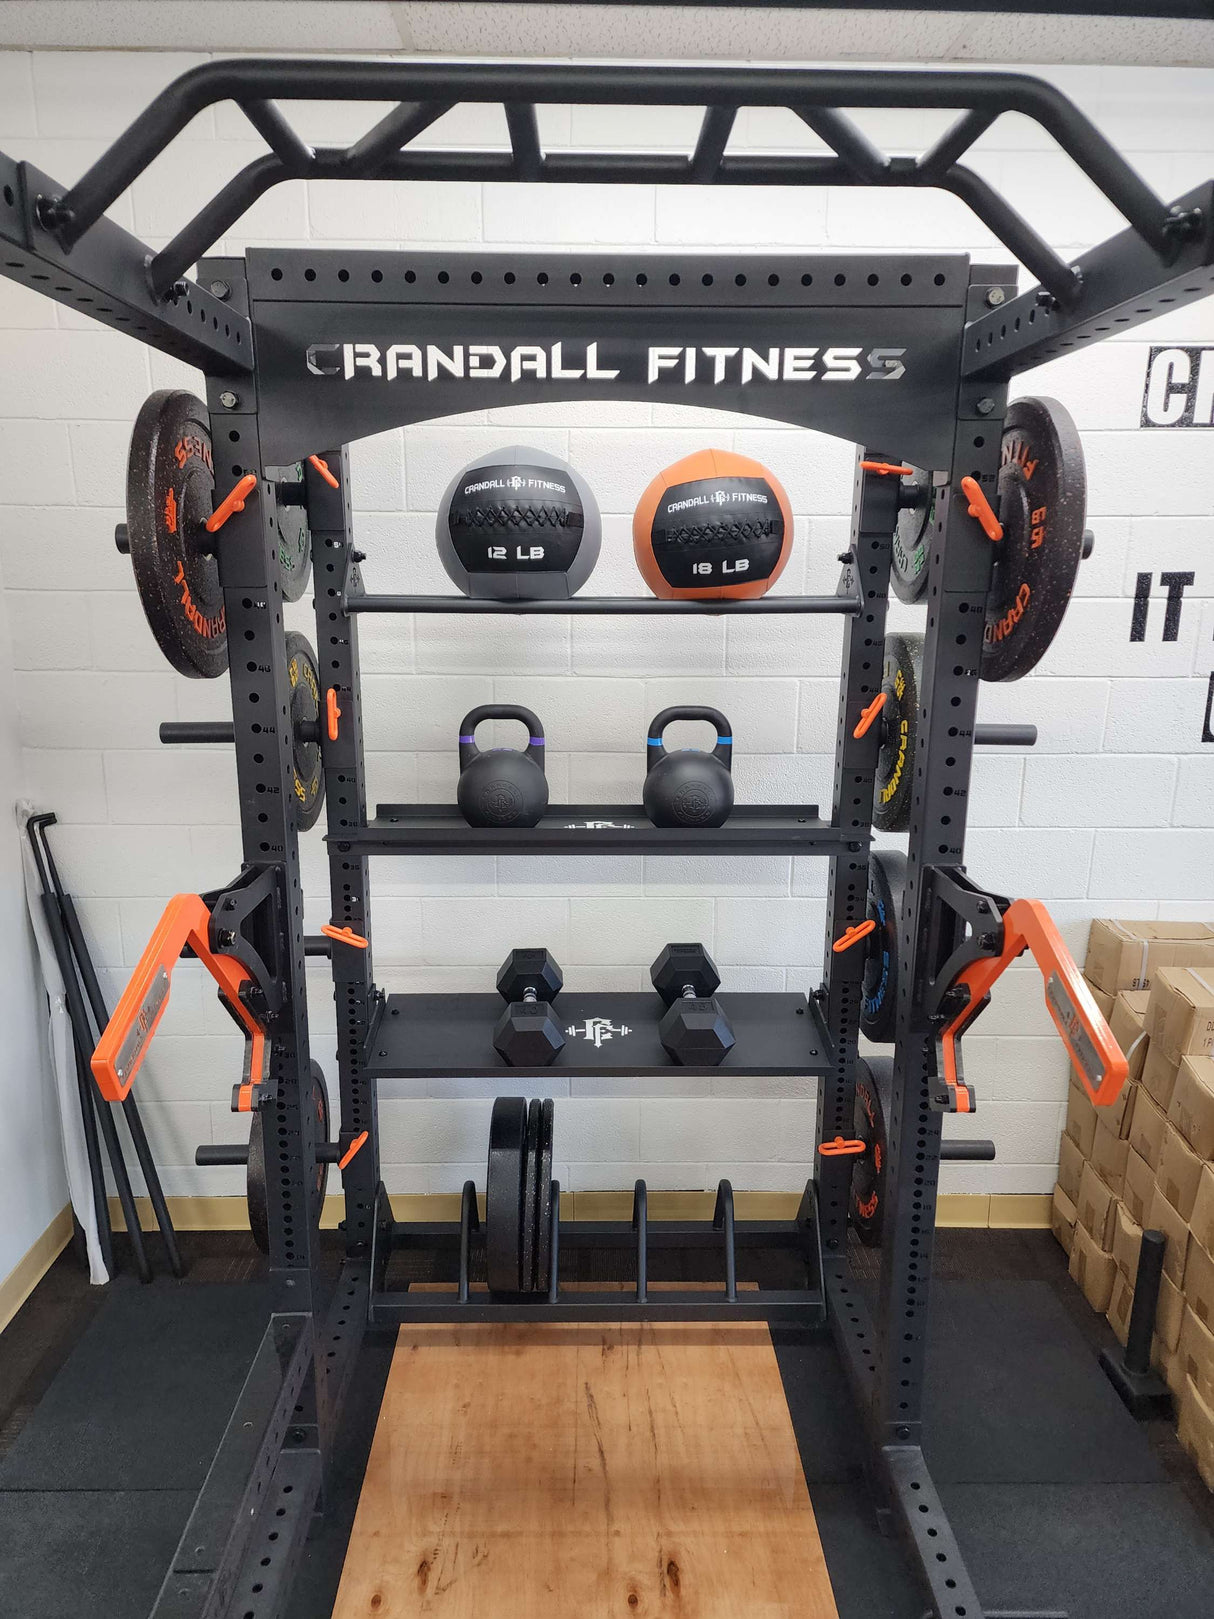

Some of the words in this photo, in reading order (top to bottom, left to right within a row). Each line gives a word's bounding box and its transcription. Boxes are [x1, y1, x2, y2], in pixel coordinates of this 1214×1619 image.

[306, 342, 620, 382] CRANDALL
[648, 347, 907, 384] FITNESS
[464, 480, 505, 495] CRANDALL
[528, 479, 566, 493] FITNESS
[667, 496, 709, 513] CRANDALL
[732, 493, 768, 504] FITNESS
[487, 547, 507, 559] 12
[516, 546, 545, 560] LB
[692, 562, 712, 575] 18
[722, 558, 750, 574] LB
[1130, 571, 1195, 642] IT
